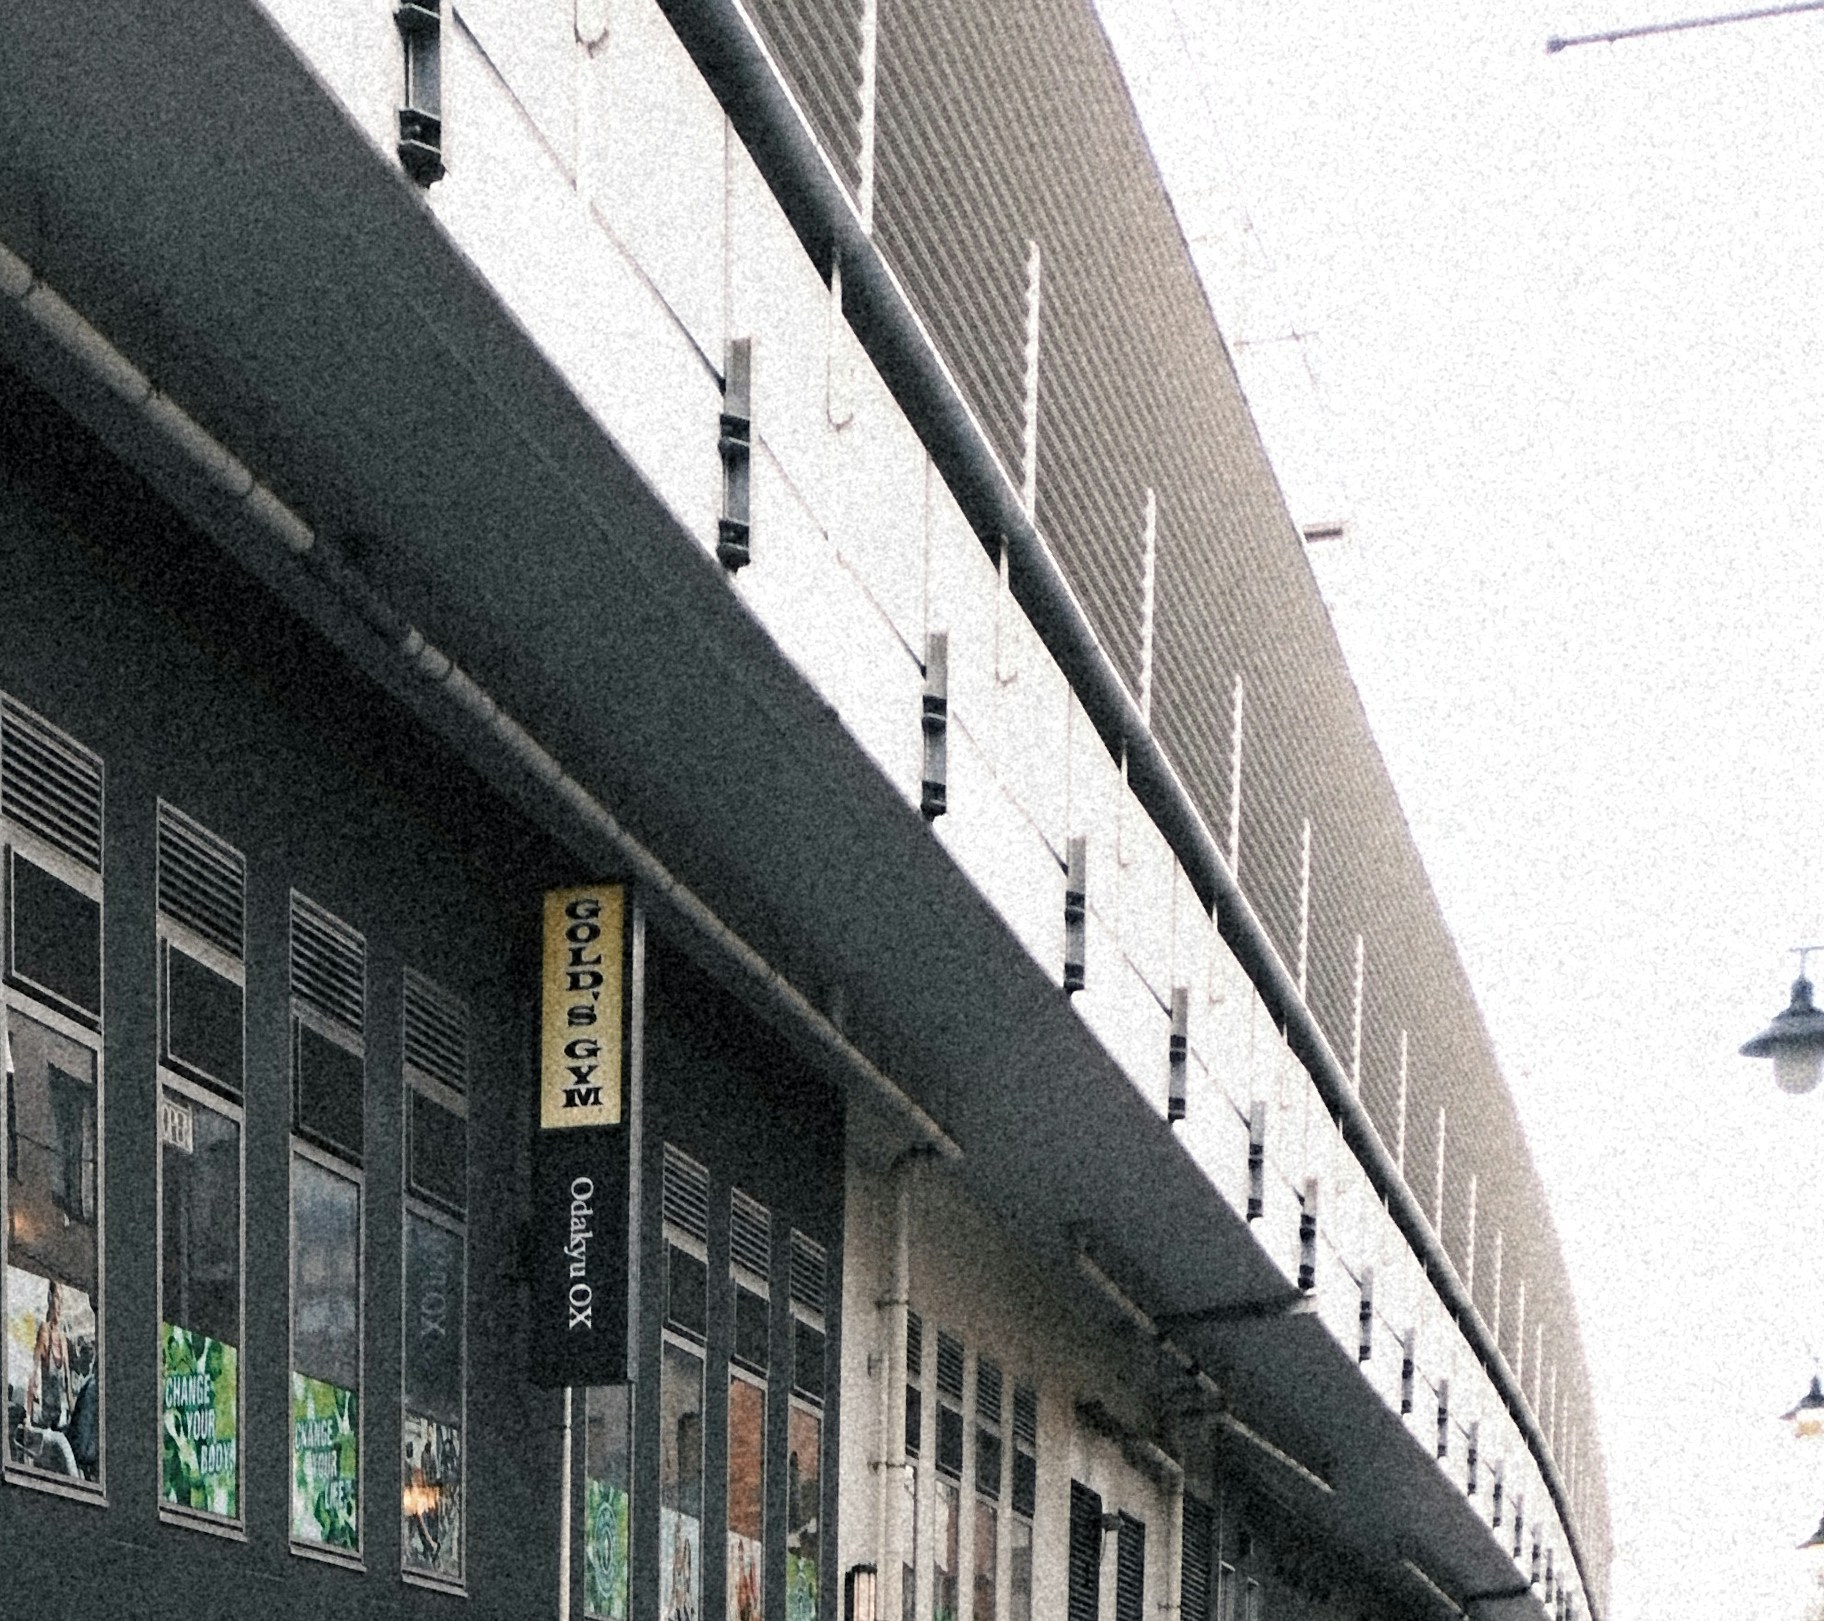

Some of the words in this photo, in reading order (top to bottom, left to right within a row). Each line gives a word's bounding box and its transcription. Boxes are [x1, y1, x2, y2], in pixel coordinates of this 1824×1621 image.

[565, 898, 604, 1027] GOLD'S
[562, 1038, 604, 1108] GYM
[563, 1176, 594, 1278] Odakyu
[569, 1283, 593, 1331] OX
[165, 1374, 212, 1408] CHANGE
[186, 1408, 216, 1443] YOUR
[295, 1419, 334, 1450] CHANGE
